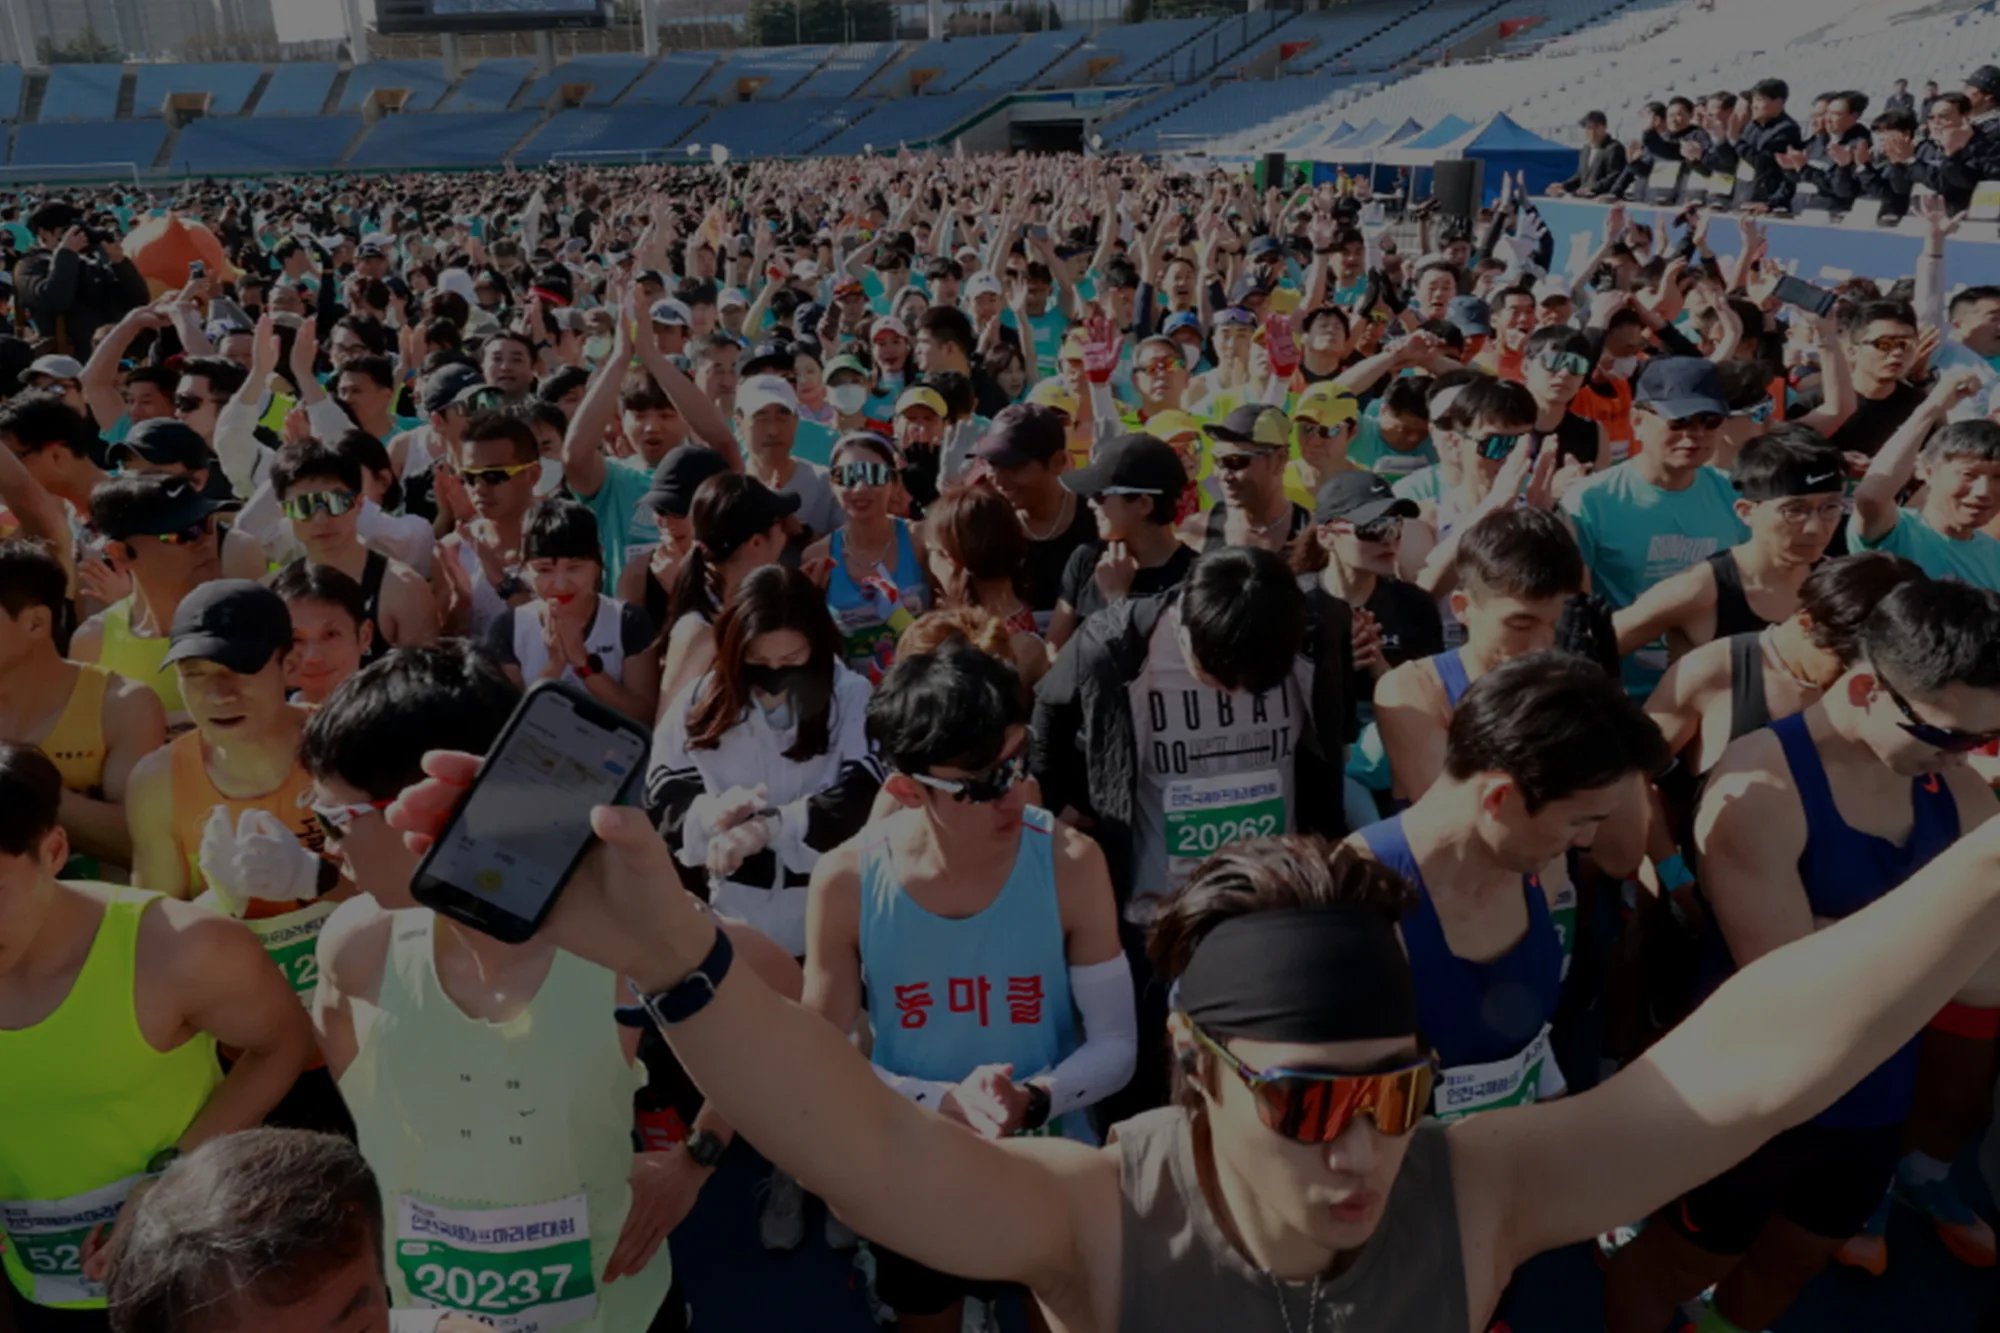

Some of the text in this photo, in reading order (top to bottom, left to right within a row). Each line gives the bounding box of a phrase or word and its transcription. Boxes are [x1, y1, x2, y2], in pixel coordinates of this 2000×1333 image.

[1149, 677, 1290, 732] DUBAI
[1177, 814, 1277, 851] 20262
[27, 1243, 81, 1272] 52
[414, 1262, 573, 1309] 20237
